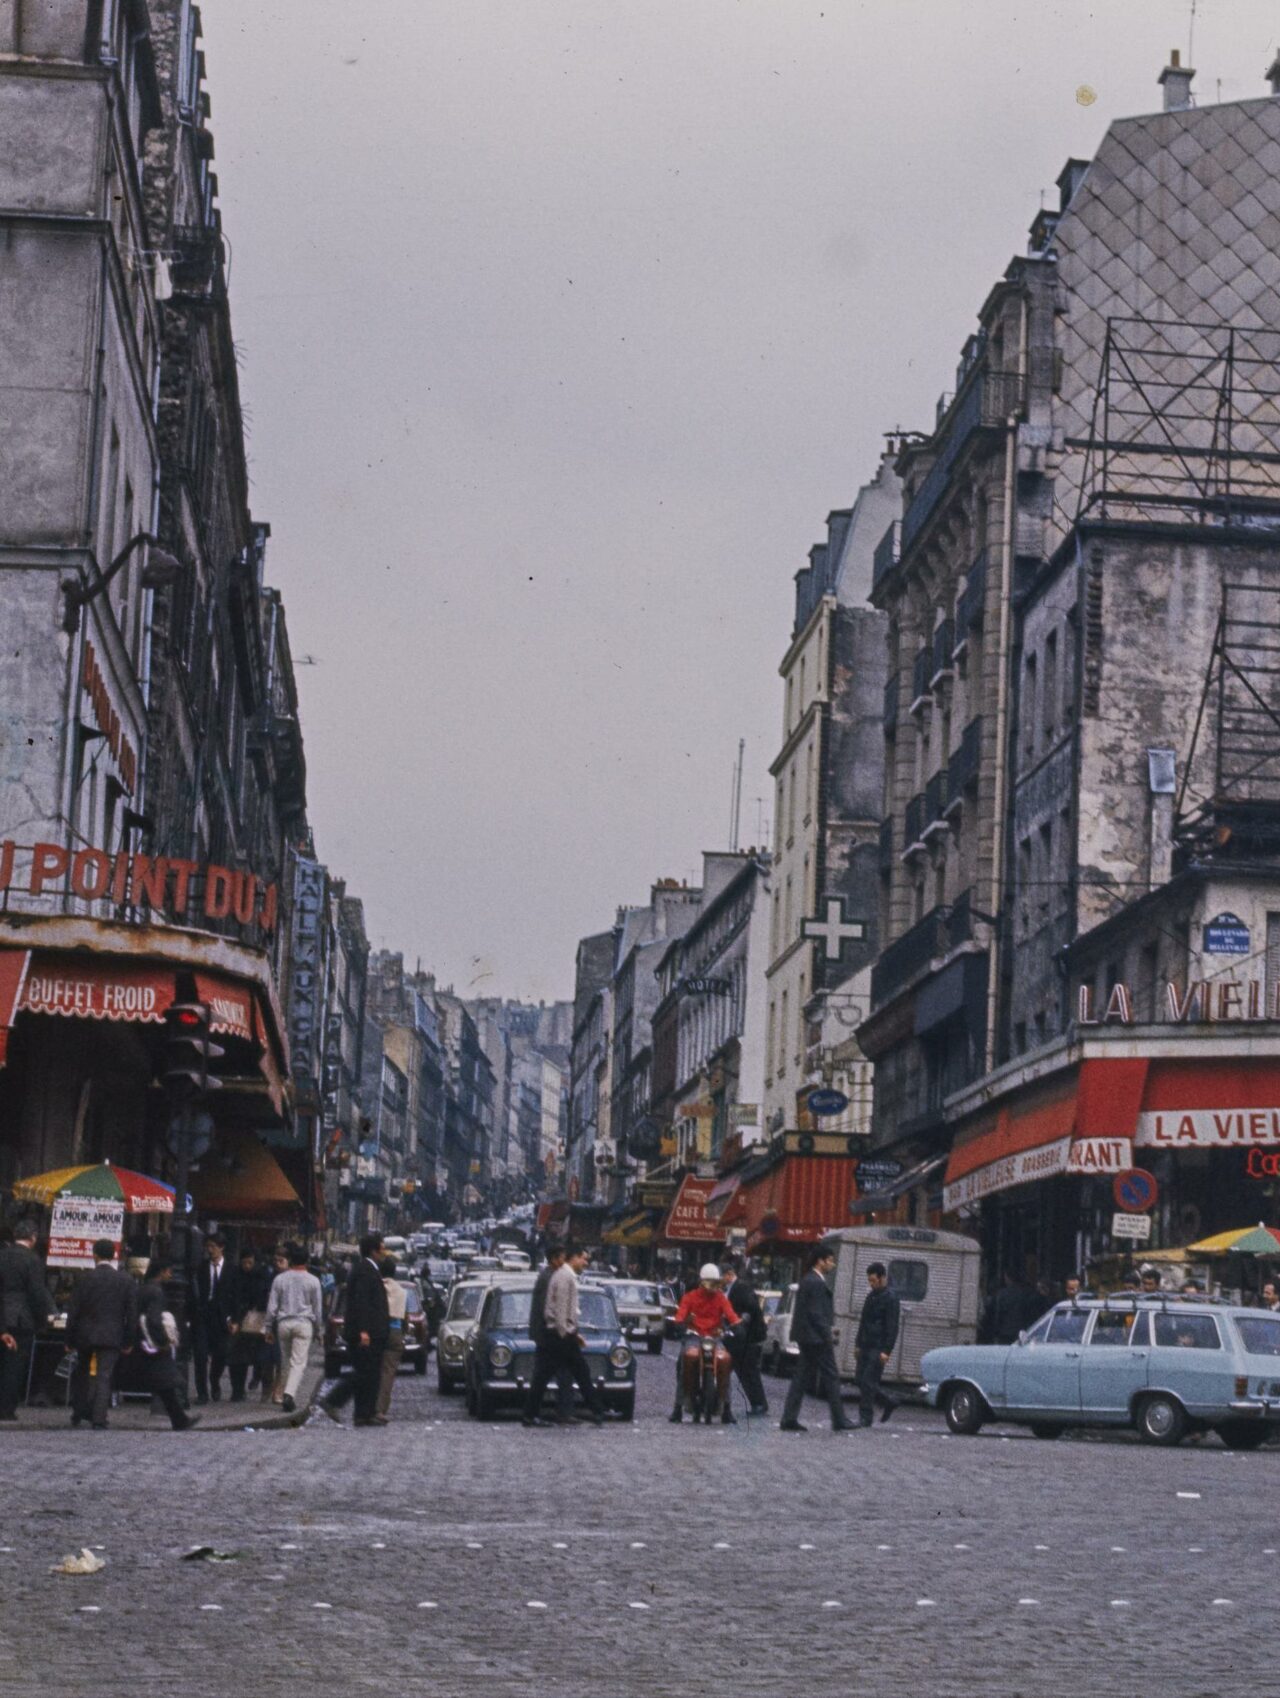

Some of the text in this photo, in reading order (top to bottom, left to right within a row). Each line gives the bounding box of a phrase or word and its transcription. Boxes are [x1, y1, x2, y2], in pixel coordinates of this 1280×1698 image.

[29, 842, 199, 914] POINT
[204, 864, 256, 923] DU
[29, 977, 156, 1011] BUFFET FROID
[1079, 982, 1134, 1025] LA
[1155, 1115, 1198, 1141] LA
[1247, 1147, 1280, 1179] La
